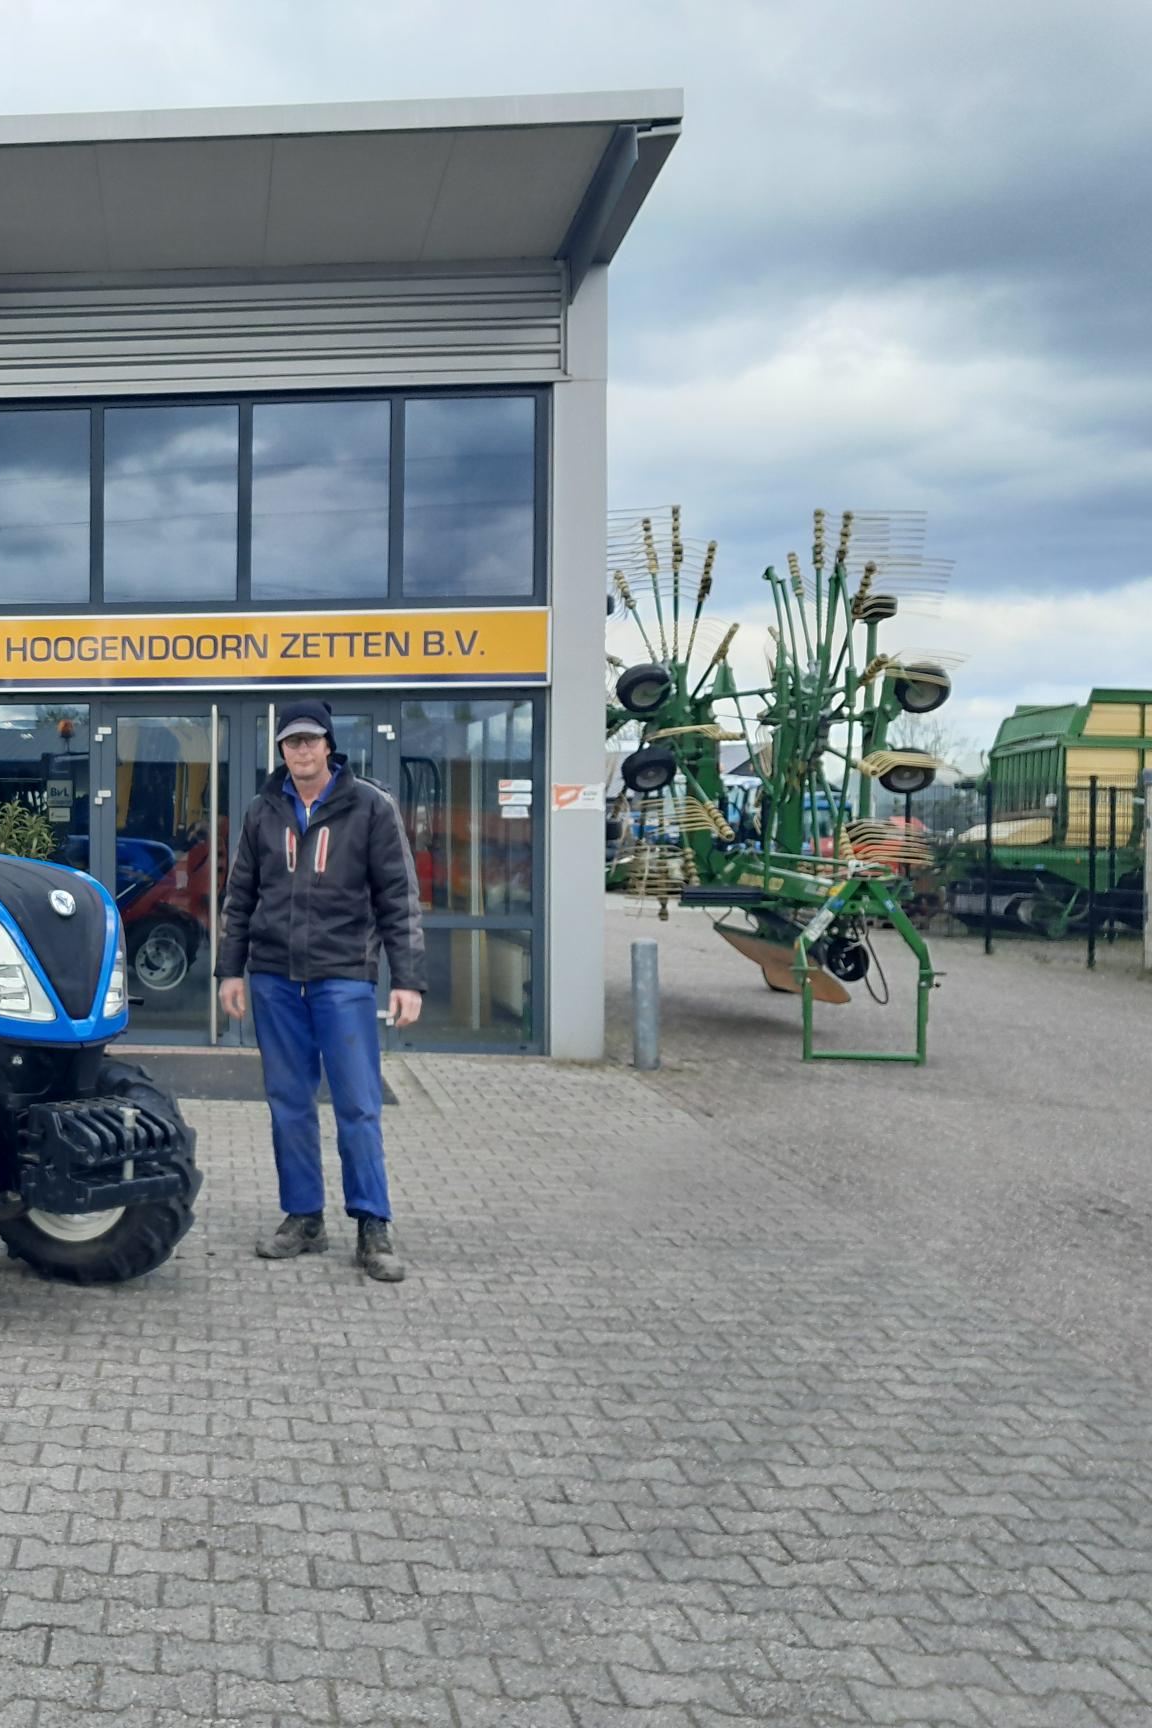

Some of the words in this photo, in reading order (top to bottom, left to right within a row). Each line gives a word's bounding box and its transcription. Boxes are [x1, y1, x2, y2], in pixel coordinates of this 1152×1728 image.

[5, 633, 268, 662] HOOGENDOORN
[279, 631, 411, 659] ZETTEN
[423, 630, 486, 656] B.V.
